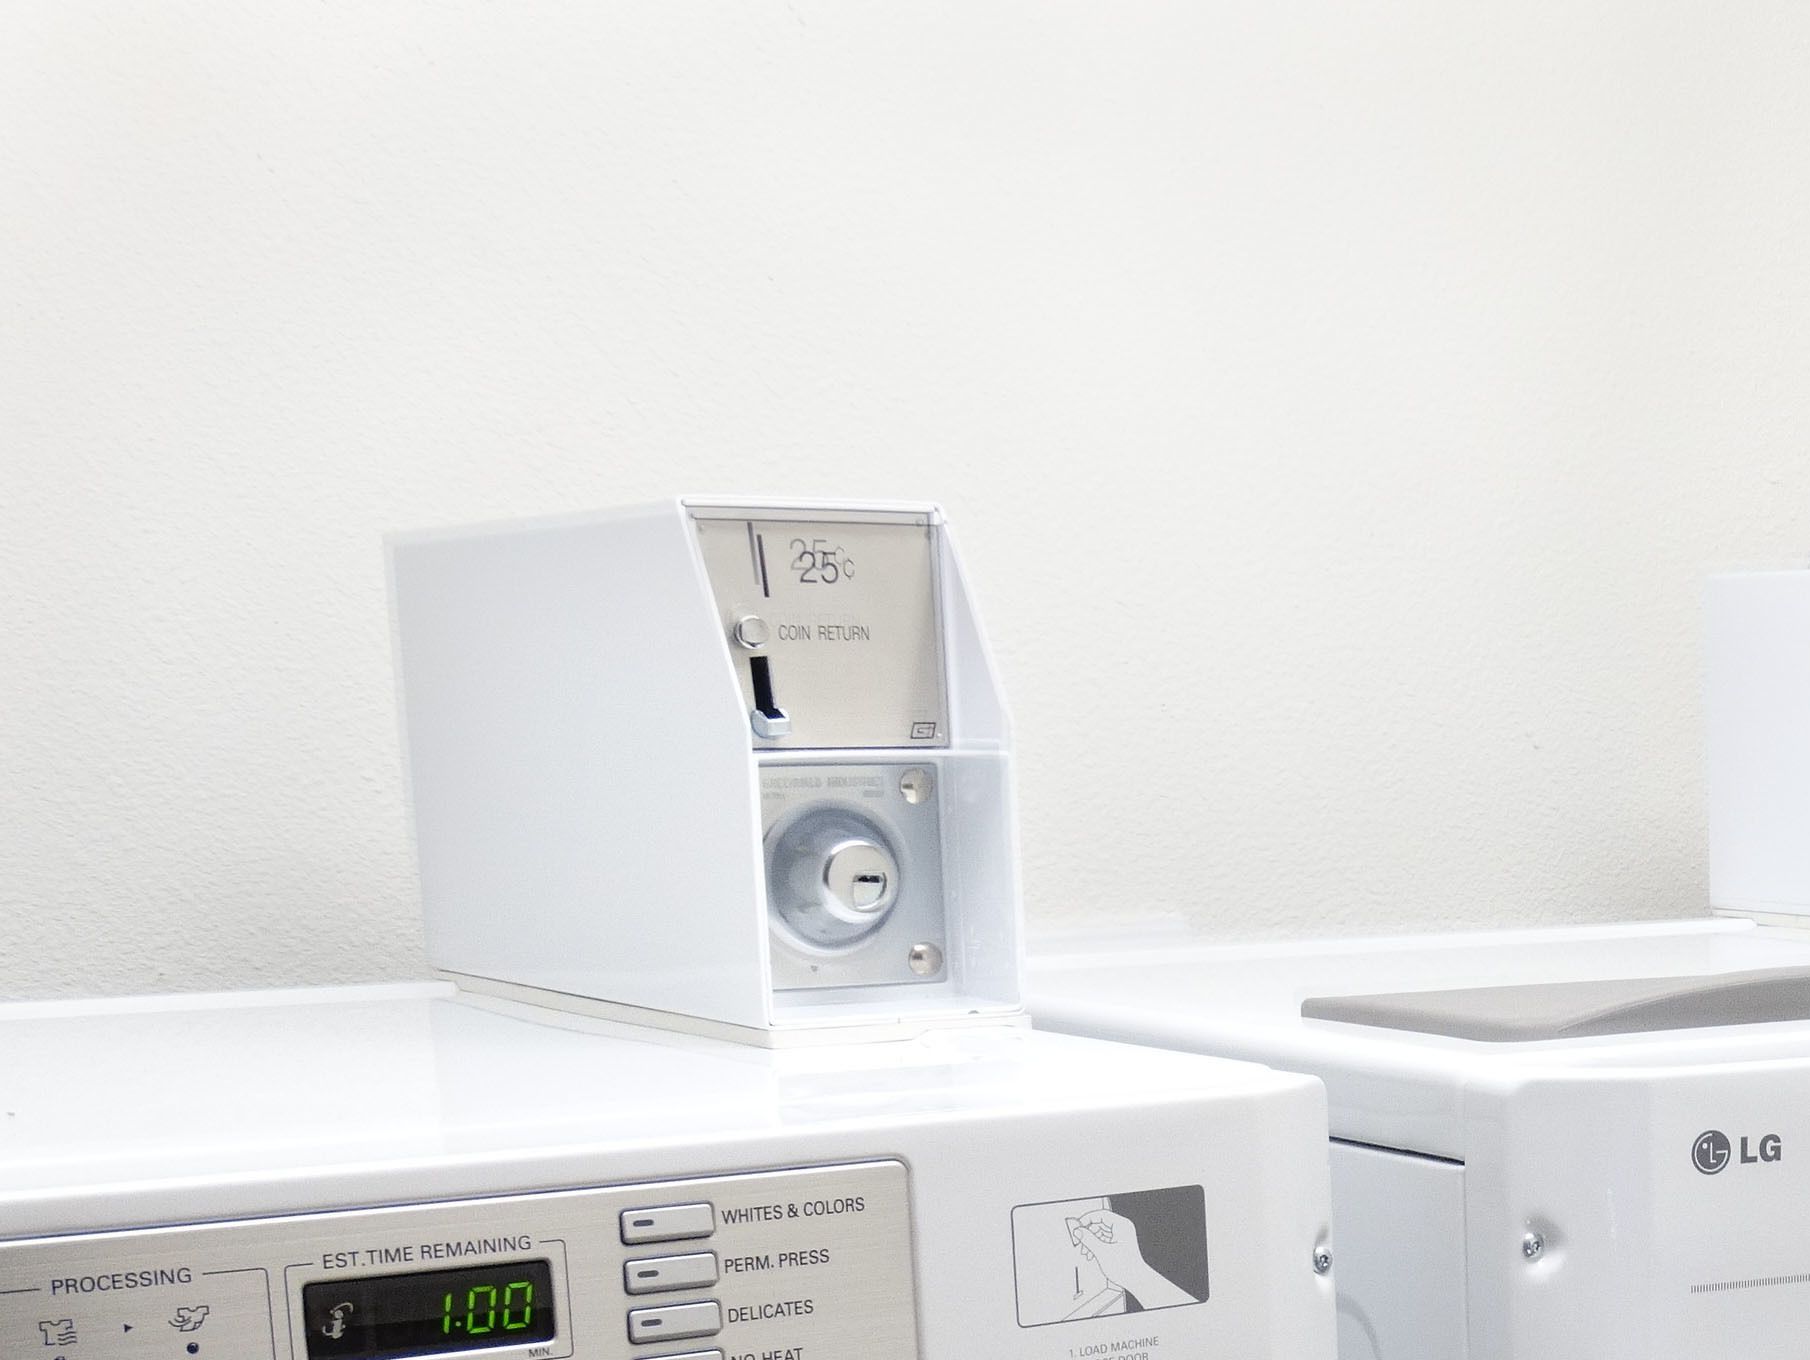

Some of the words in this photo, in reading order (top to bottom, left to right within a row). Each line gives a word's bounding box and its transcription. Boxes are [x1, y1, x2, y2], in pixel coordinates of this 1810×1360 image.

[778, 625, 810, 640] COIN
[818, 625, 870, 640] RETURN
[1740, 1134, 1782, 1164] LG
[722, 1206, 782, 1223] WHITES
[787, 1204, 799, 1218] &
[803, 1198, 864, 1216] COLORS
[420, 1235, 532, 1261] REMAINING
[724, 1256, 774, 1272] PERM.
[778, 1250, 829, 1267] PRESS
[51, 1267, 192, 1295] PROCESSING
[728, 1301, 813, 1322] DELICATES
[1079, 1344, 1108, 1357] LOAD
[1111, 1336, 1159, 1352] MACHINE
